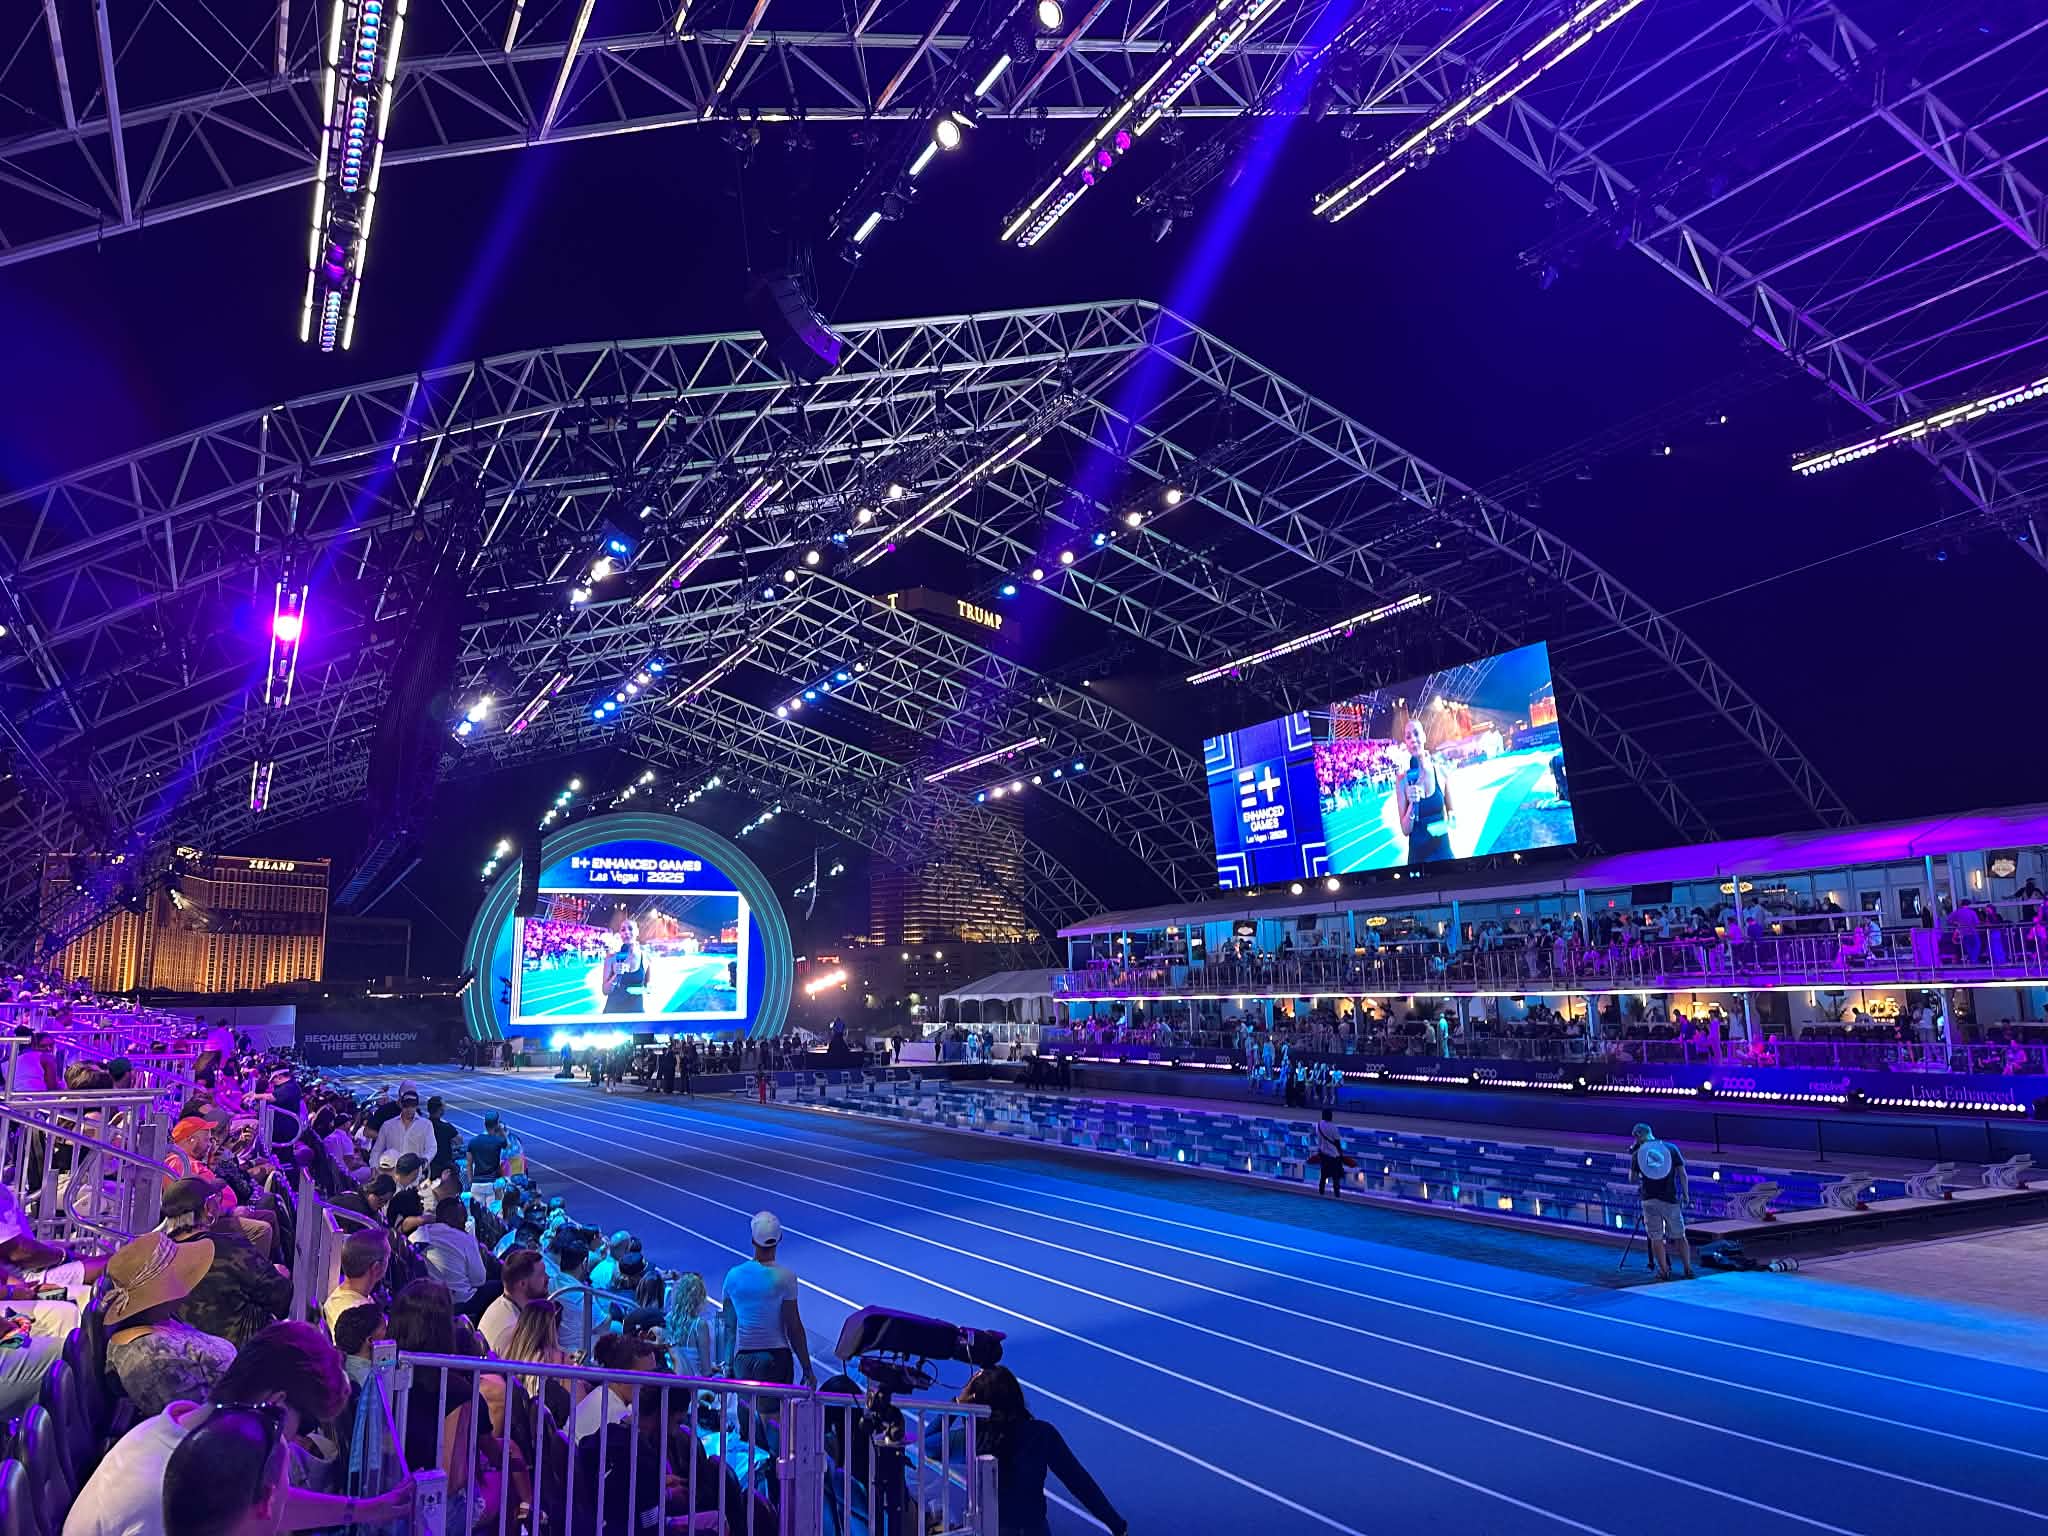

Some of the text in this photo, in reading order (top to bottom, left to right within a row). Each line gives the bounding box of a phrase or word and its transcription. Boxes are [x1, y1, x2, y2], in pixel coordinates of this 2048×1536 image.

[957, 599, 1003, 630] TRUMP
[1242, 805, 1285, 823] ENHANCED
[1250, 817, 1279, 832] GAMES
[249, 859, 295, 872] ISLAND
[591, 857, 658, 871] ENHANCED
[658, 859, 702, 872] GAMES
[589, 870, 609, 882] Las
[609, 871, 640, 885] Vegas
[304, 1032, 418, 1043] BECAUSE YOU KNOW
[321, 1041, 401, 1051] THERE'S MORE
[1911, 1084, 2015, 1104] Live Enhanced
